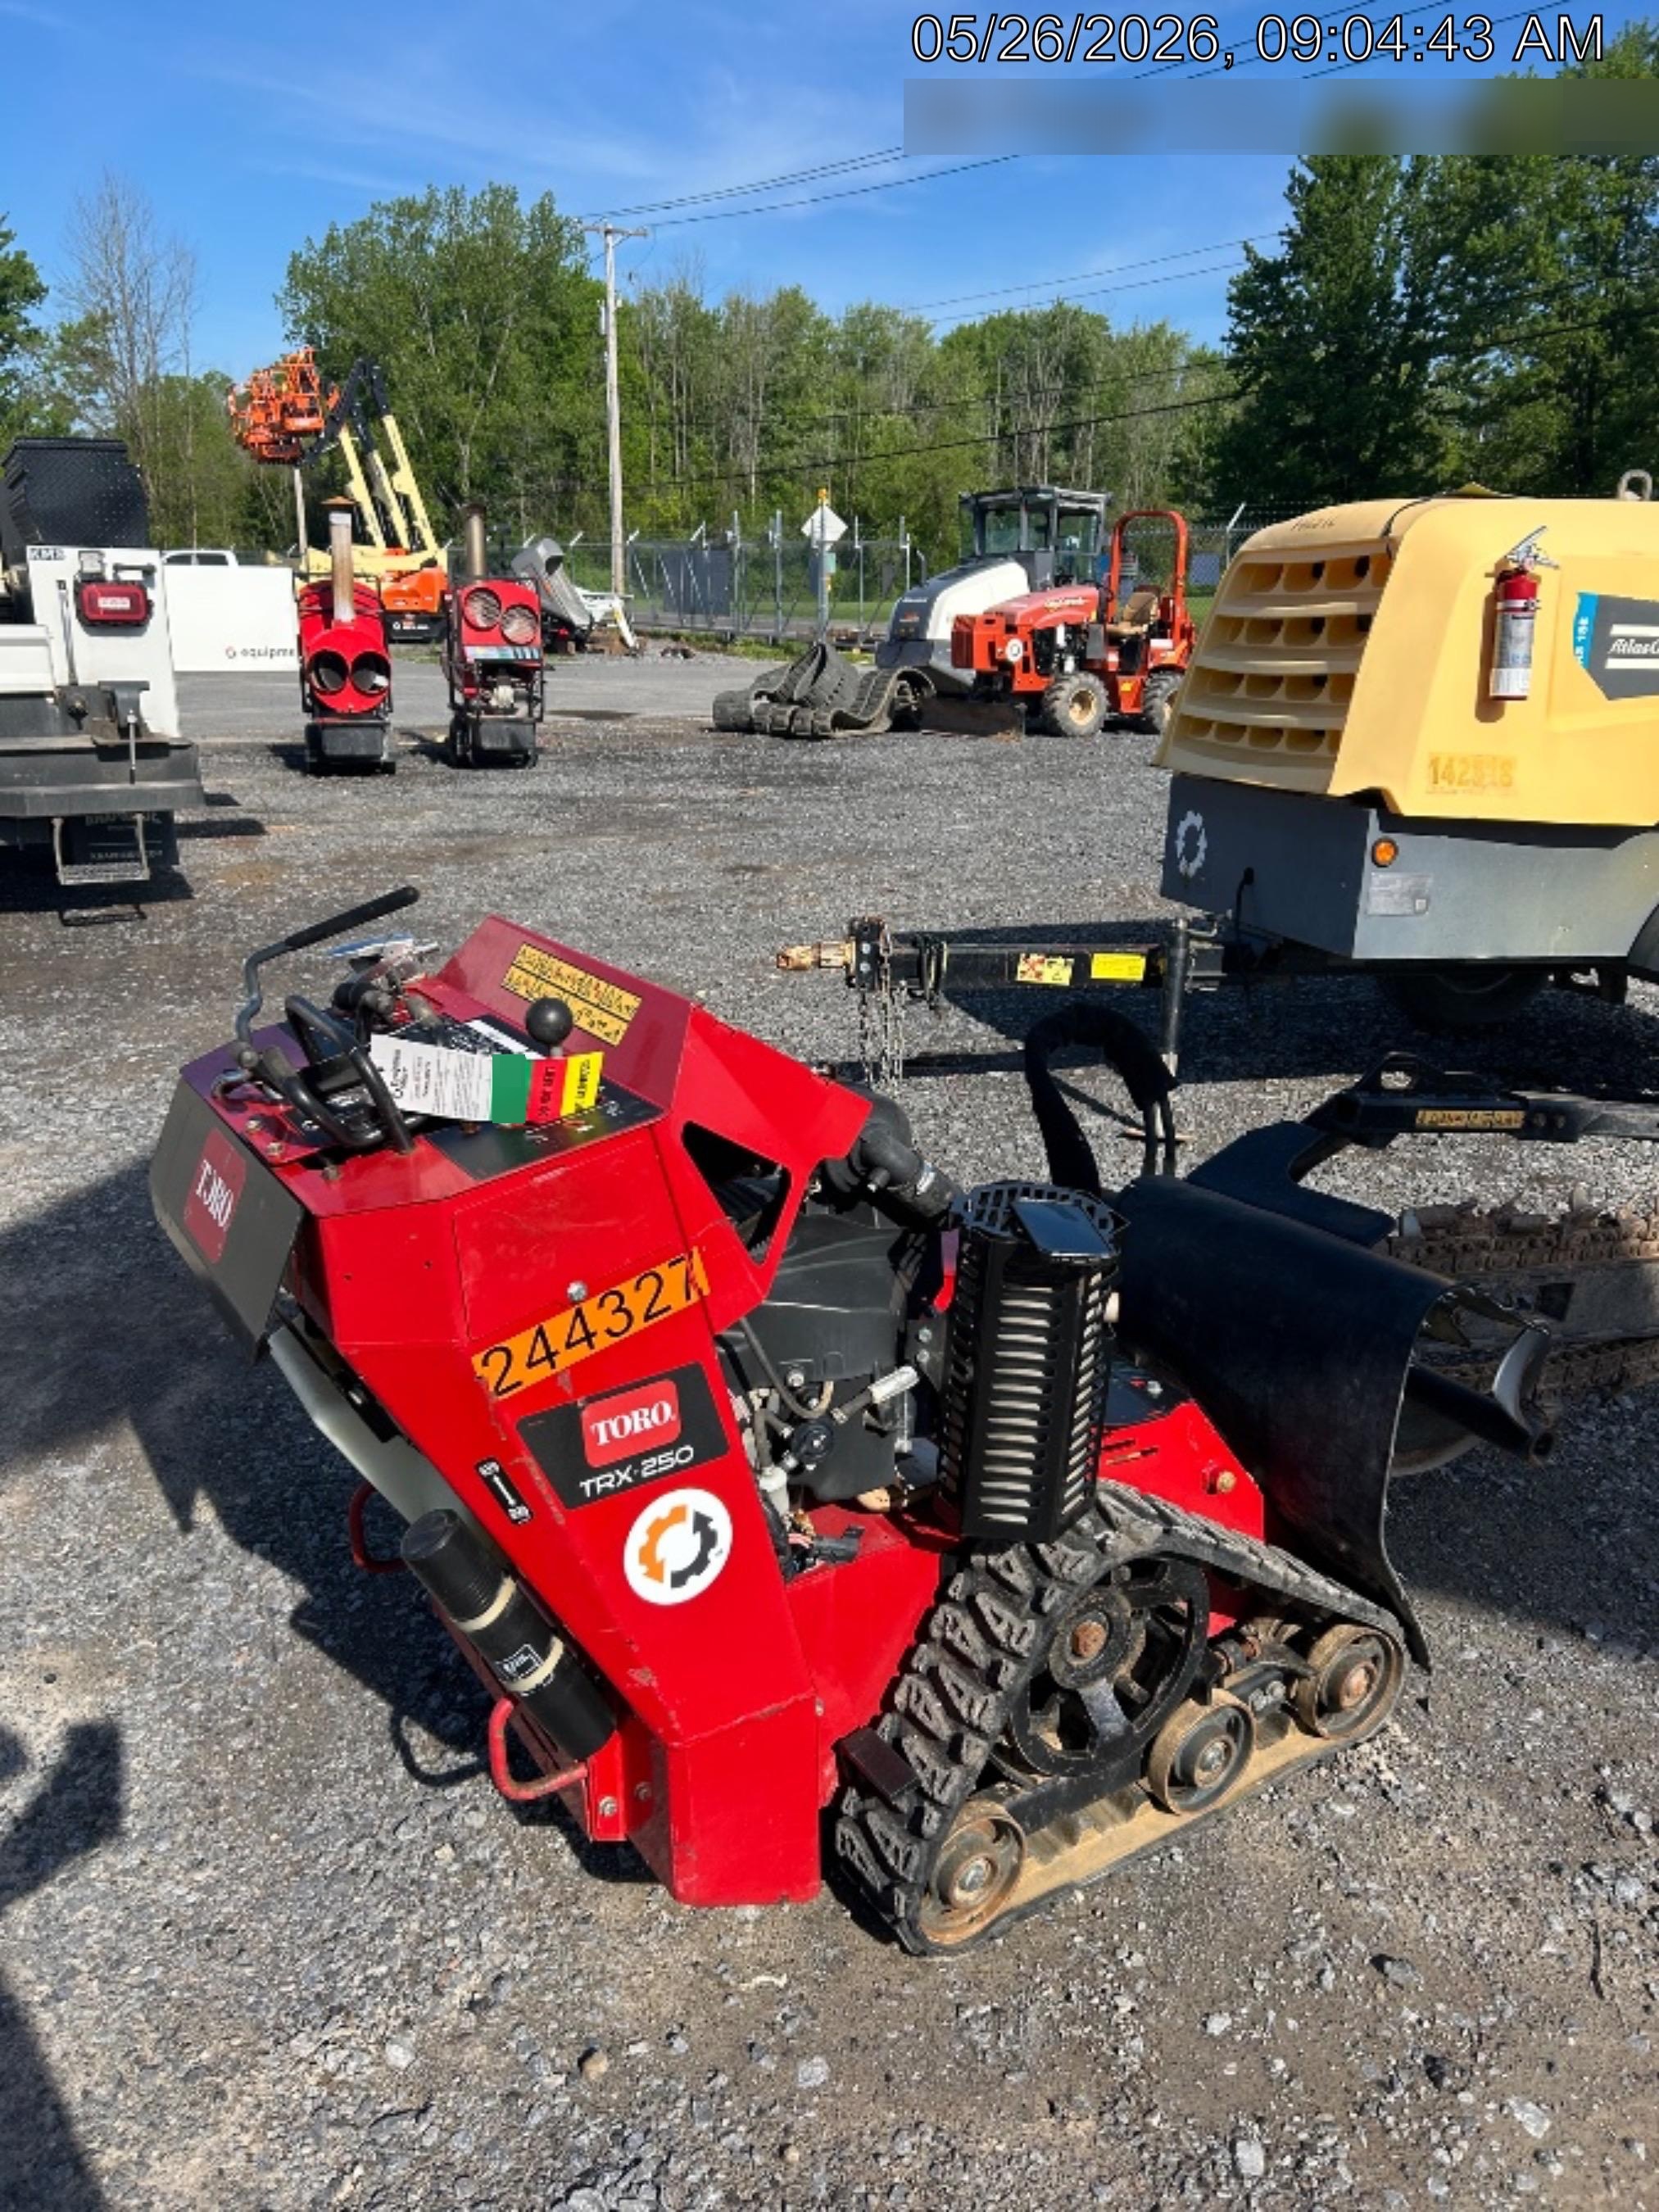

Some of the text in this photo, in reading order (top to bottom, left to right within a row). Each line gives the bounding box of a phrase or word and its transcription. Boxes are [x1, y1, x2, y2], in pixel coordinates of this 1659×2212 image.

[195, 1158, 234, 1231] TORO
[480, 1249, 695, 1398] 244327
[589, 1399, 676, 1447] TORO
